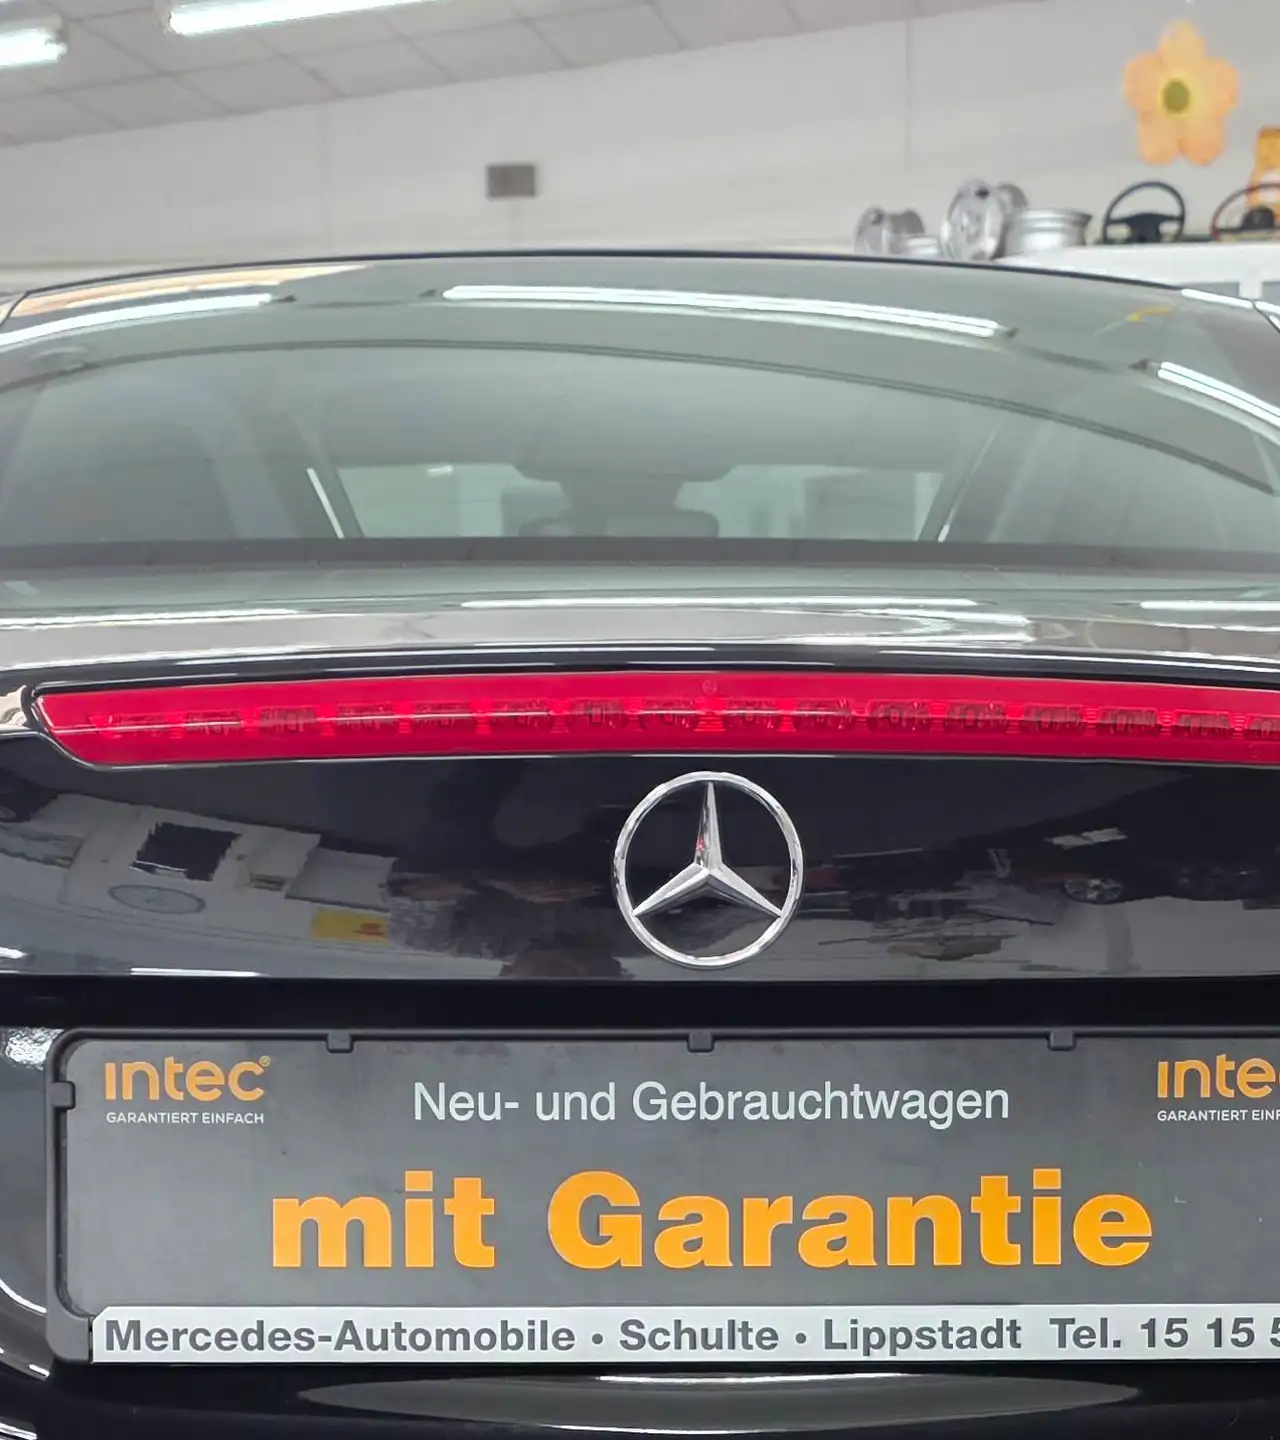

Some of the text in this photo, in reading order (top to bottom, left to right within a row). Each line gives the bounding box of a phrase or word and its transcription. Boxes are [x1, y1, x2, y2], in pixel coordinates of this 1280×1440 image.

[104, 1056, 266, 1102] intec
[105, 1111, 265, 1125] GARANTIERT EINFACH
[413, 1080, 1010, 1130] Neu- und Gebrauchtwagen
[1156, 1108, 1249, 1122] GARANTIERT
[272, 1167, 1153, 1268] mit Garantie
[104, 1318, 576, 1353] Mercedes-Automobile
[619, 1317, 780, 1352] Schulte
[822, 1317, 1023, 1358] Lippstadt
[1048, 1316, 1122, 1349] Tel.
[1140, 1316, 1190, 1349] 15
[1206, 1316, 1256, 1349] 15
